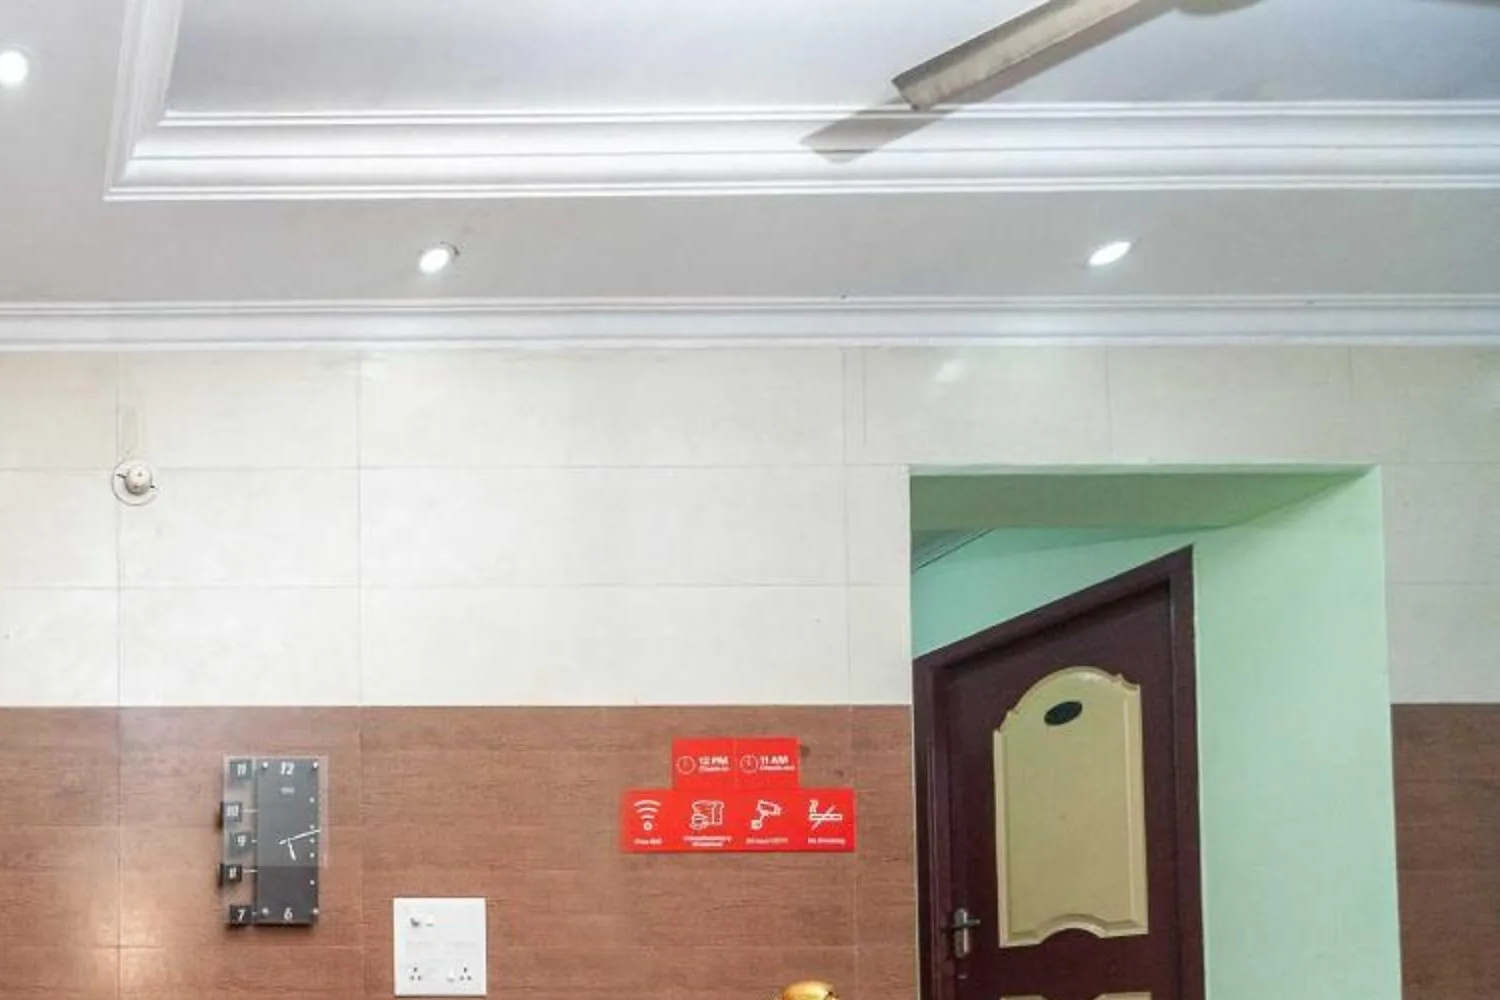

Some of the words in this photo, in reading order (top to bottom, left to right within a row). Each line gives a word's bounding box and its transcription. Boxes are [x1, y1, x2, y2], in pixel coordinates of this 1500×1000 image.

[711, 755, 729, 765] PM
[760, 755, 769, 765] 11
[771, 755, 789, 765] AM
[237, 763, 247, 777] 11
[280, 762, 295, 775] 12
[227, 805, 239, 817] 10
[237, 908, 246, 921] 7
[283, 907, 293, 921] 6
